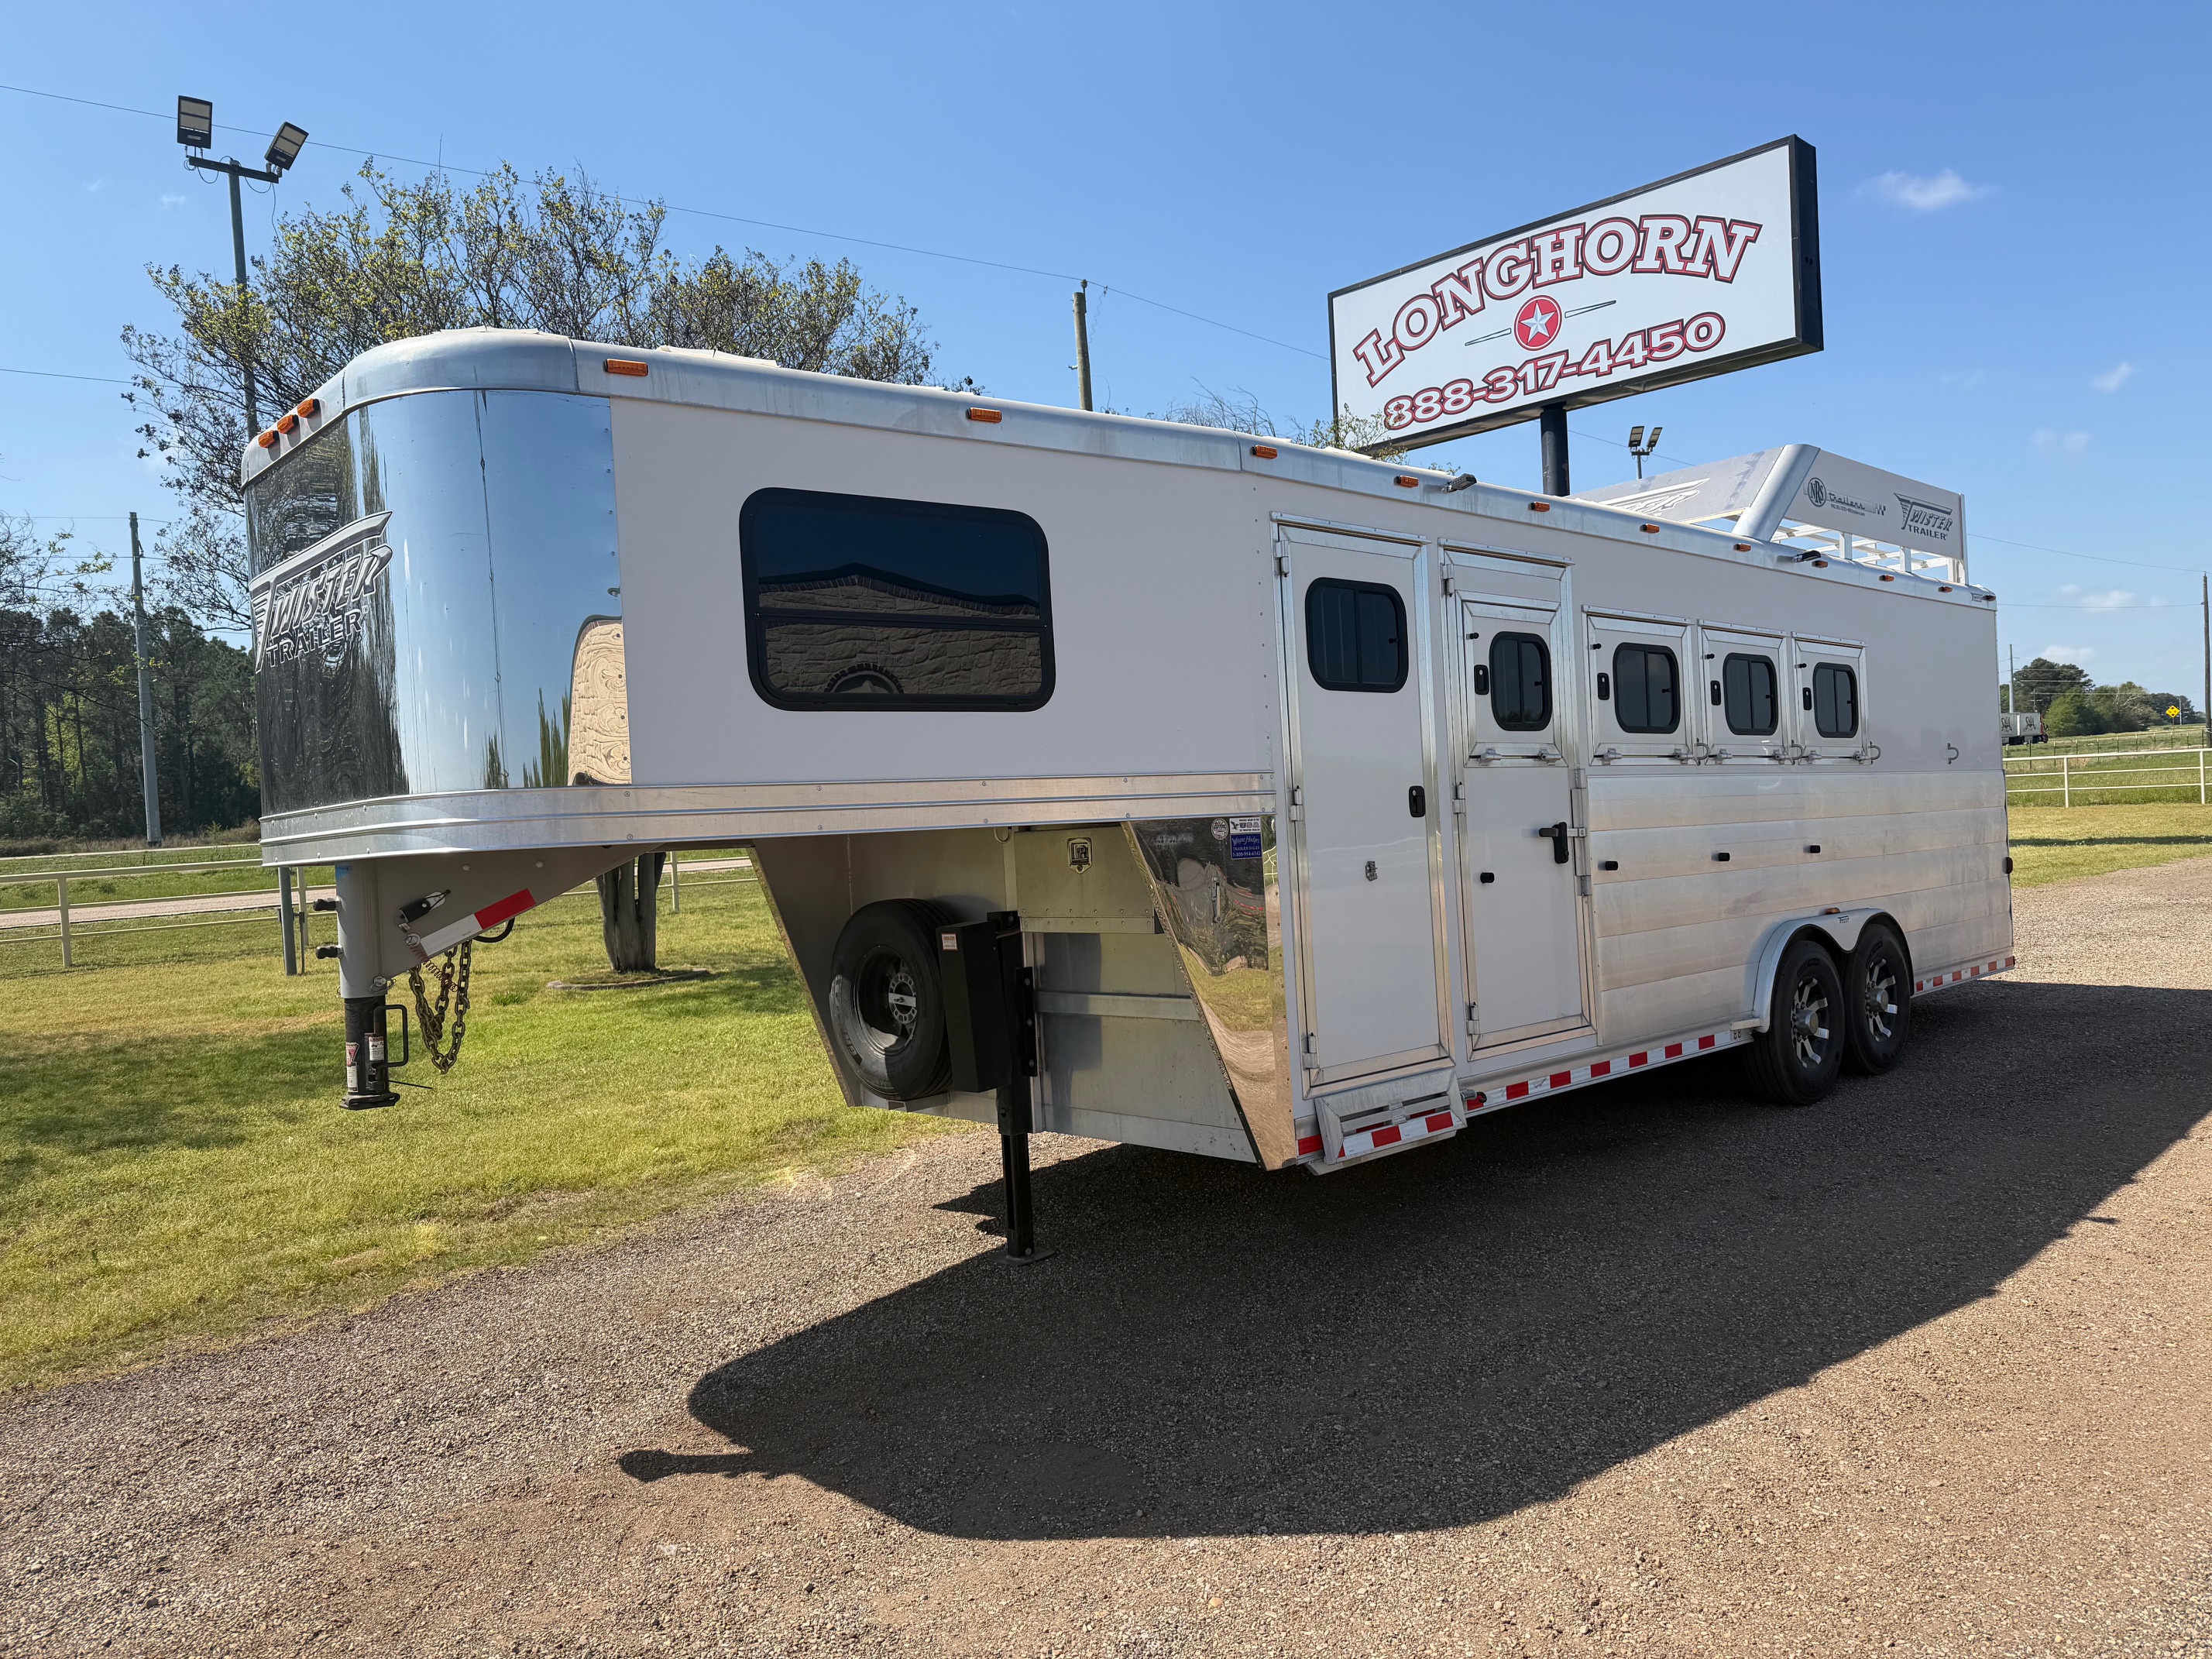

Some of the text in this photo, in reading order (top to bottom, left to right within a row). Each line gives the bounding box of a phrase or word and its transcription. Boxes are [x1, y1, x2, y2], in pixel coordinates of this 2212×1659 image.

[1353, 215, 1763, 387] LONGHORN
[1384, 312, 1726, 431] 888-317-4450
[1810, 480, 1825, 504] NRS
[1829, 492, 1865, 510] trailers
[1894, 493, 1953, 532] TWISTER
[1908, 524, 1947, 541] TRAILER
[249, 509, 393, 674] TWISTER
